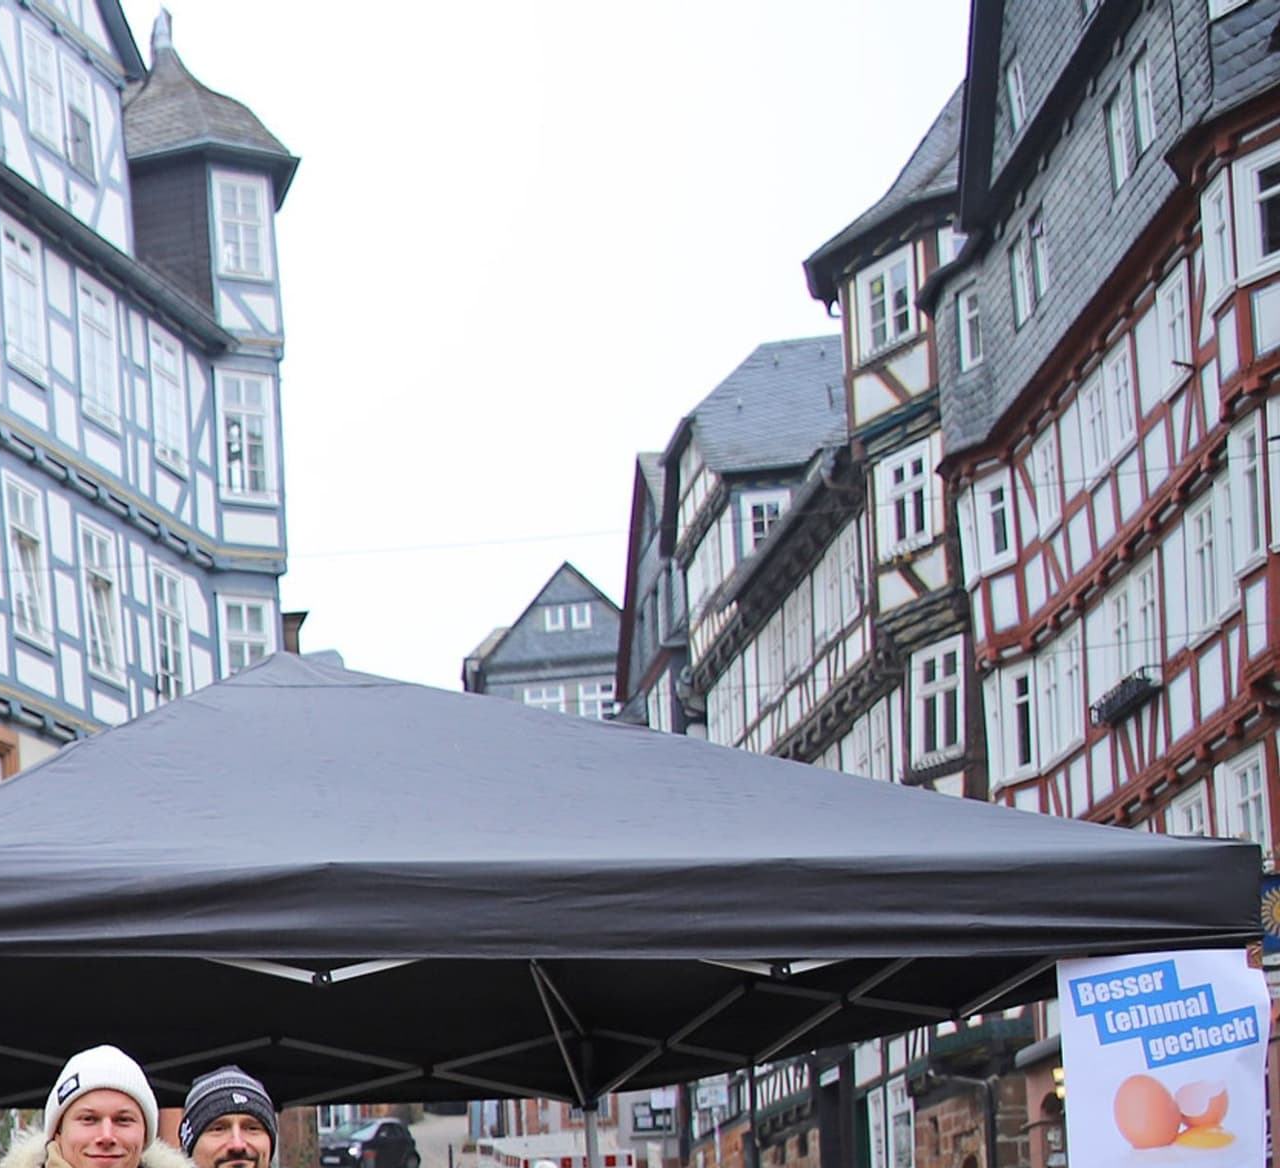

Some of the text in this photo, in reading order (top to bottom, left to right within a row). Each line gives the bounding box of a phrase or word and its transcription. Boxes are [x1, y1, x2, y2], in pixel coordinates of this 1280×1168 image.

[1076, 969, 1164, 1007] Besser
[1104, 991, 1209, 1034] (ei)nmal
[1148, 1016, 1256, 1061] gecheckt
